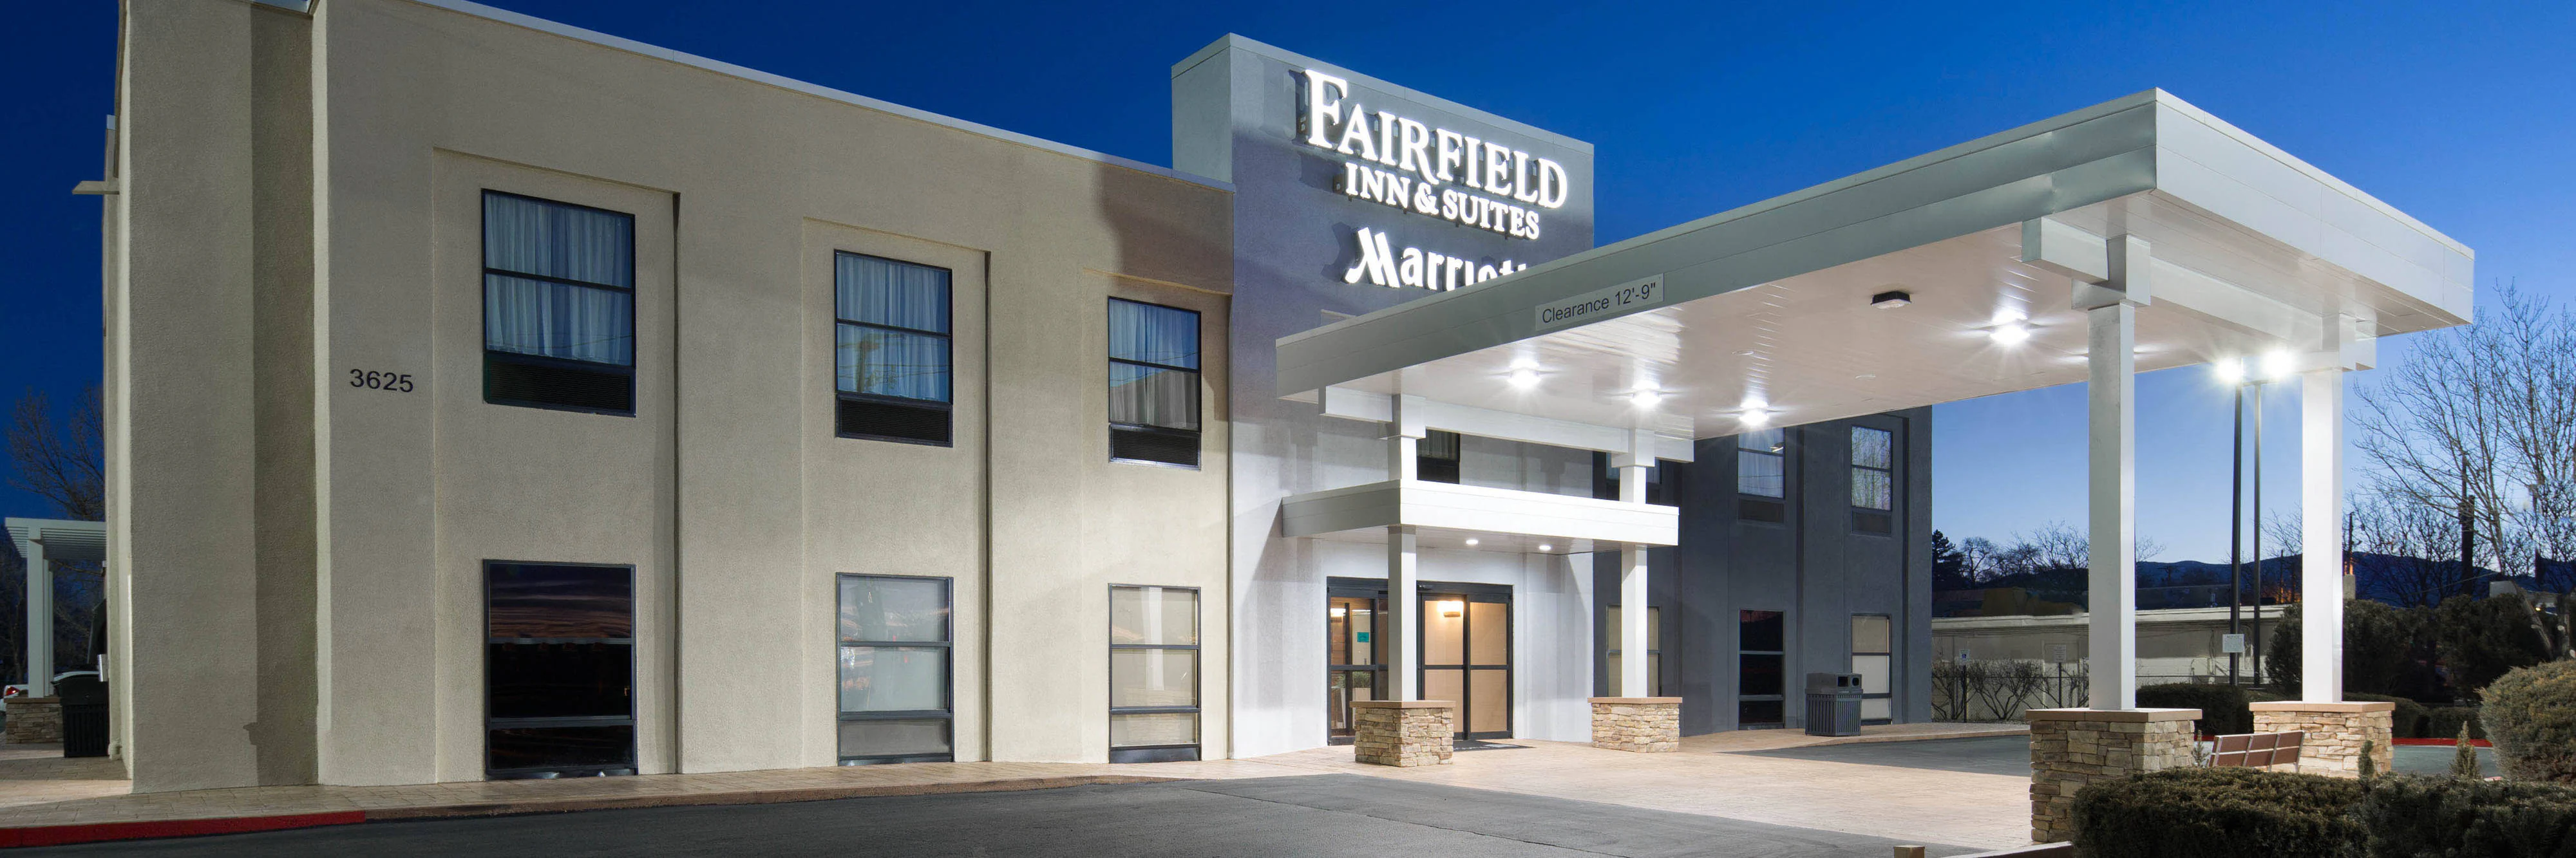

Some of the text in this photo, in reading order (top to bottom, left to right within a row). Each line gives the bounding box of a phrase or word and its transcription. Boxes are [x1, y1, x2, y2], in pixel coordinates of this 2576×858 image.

[1305, 69, 1568, 209] FAIRFIELD
[1345, 162, 1540, 240] INN & SUITES
[1345, 227, 1526, 291] Marri
[1542, 282, 1656, 323] Clearance 12'-9"
[350, 368, 413, 393] 3625
